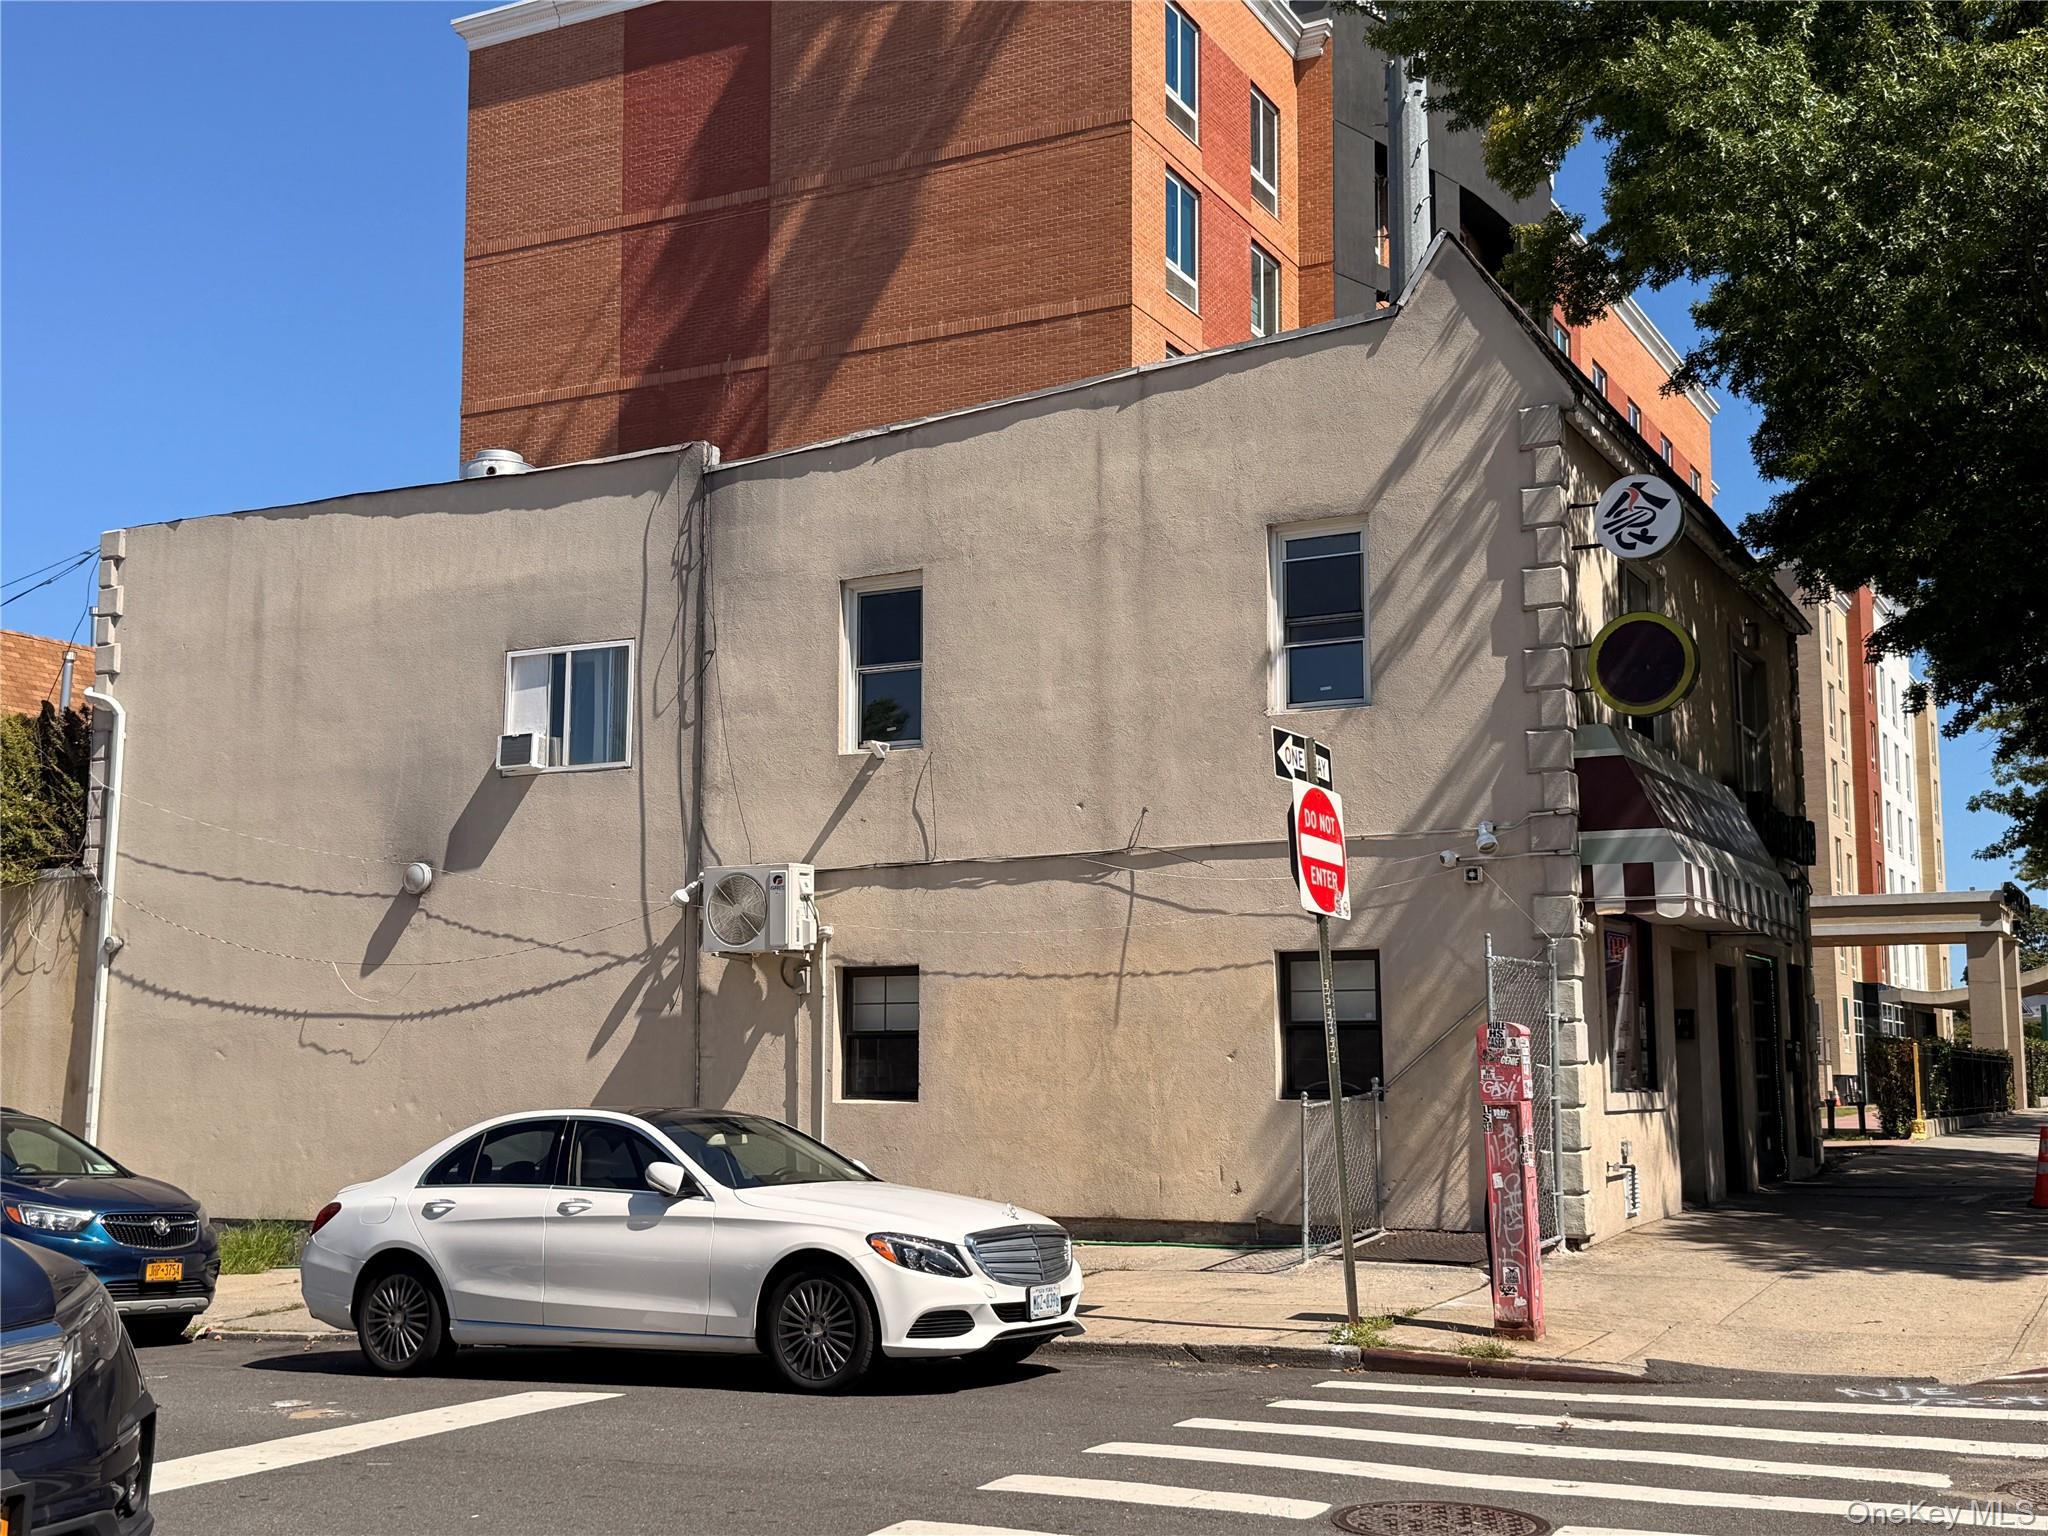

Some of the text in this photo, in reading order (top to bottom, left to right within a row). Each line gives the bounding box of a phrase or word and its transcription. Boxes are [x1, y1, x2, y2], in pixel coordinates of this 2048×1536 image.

[1285, 746, 1304, 769] ONE
[1304, 810, 1336, 836] DO NOT
[1310, 865, 1339, 890] ENTER
